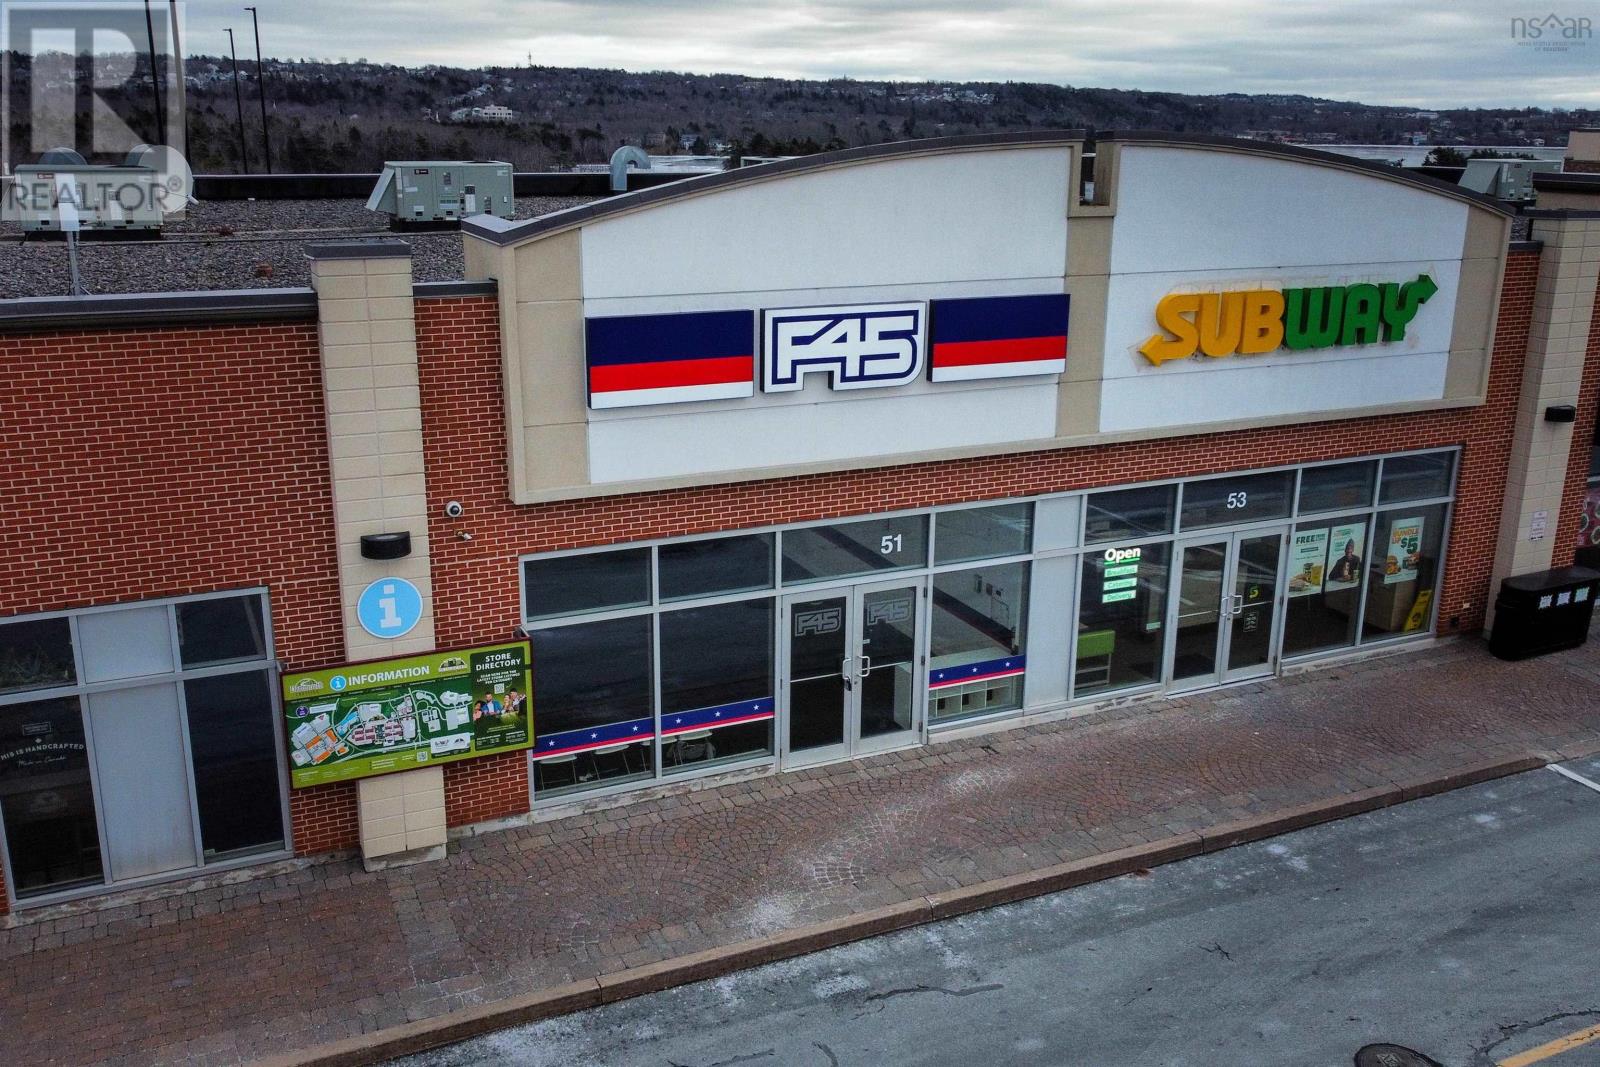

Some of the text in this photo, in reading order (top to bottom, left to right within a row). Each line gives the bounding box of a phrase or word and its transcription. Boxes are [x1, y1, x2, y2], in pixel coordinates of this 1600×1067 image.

[1139, 274, 1438, 366] SUBWAY
[771, 309, 919, 385] F45
[1227, 491, 1247, 509] 53
[880, 533, 902, 555] 51
[1296, 534, 1316, 544] FREE
[1400, 537, 1418, 554] $5
[1104, 547, 1141, 563] Open
[867, 598, 912, 625] F45
[795, 608, 841, 636] F45
[476, 659, 521, 671] DIRECTORY
[485, 653, 511, 662] STORE
[348, 665, 430, 686] INFORMATION
[25, 743, 85, 753] HANDCRAFTED
